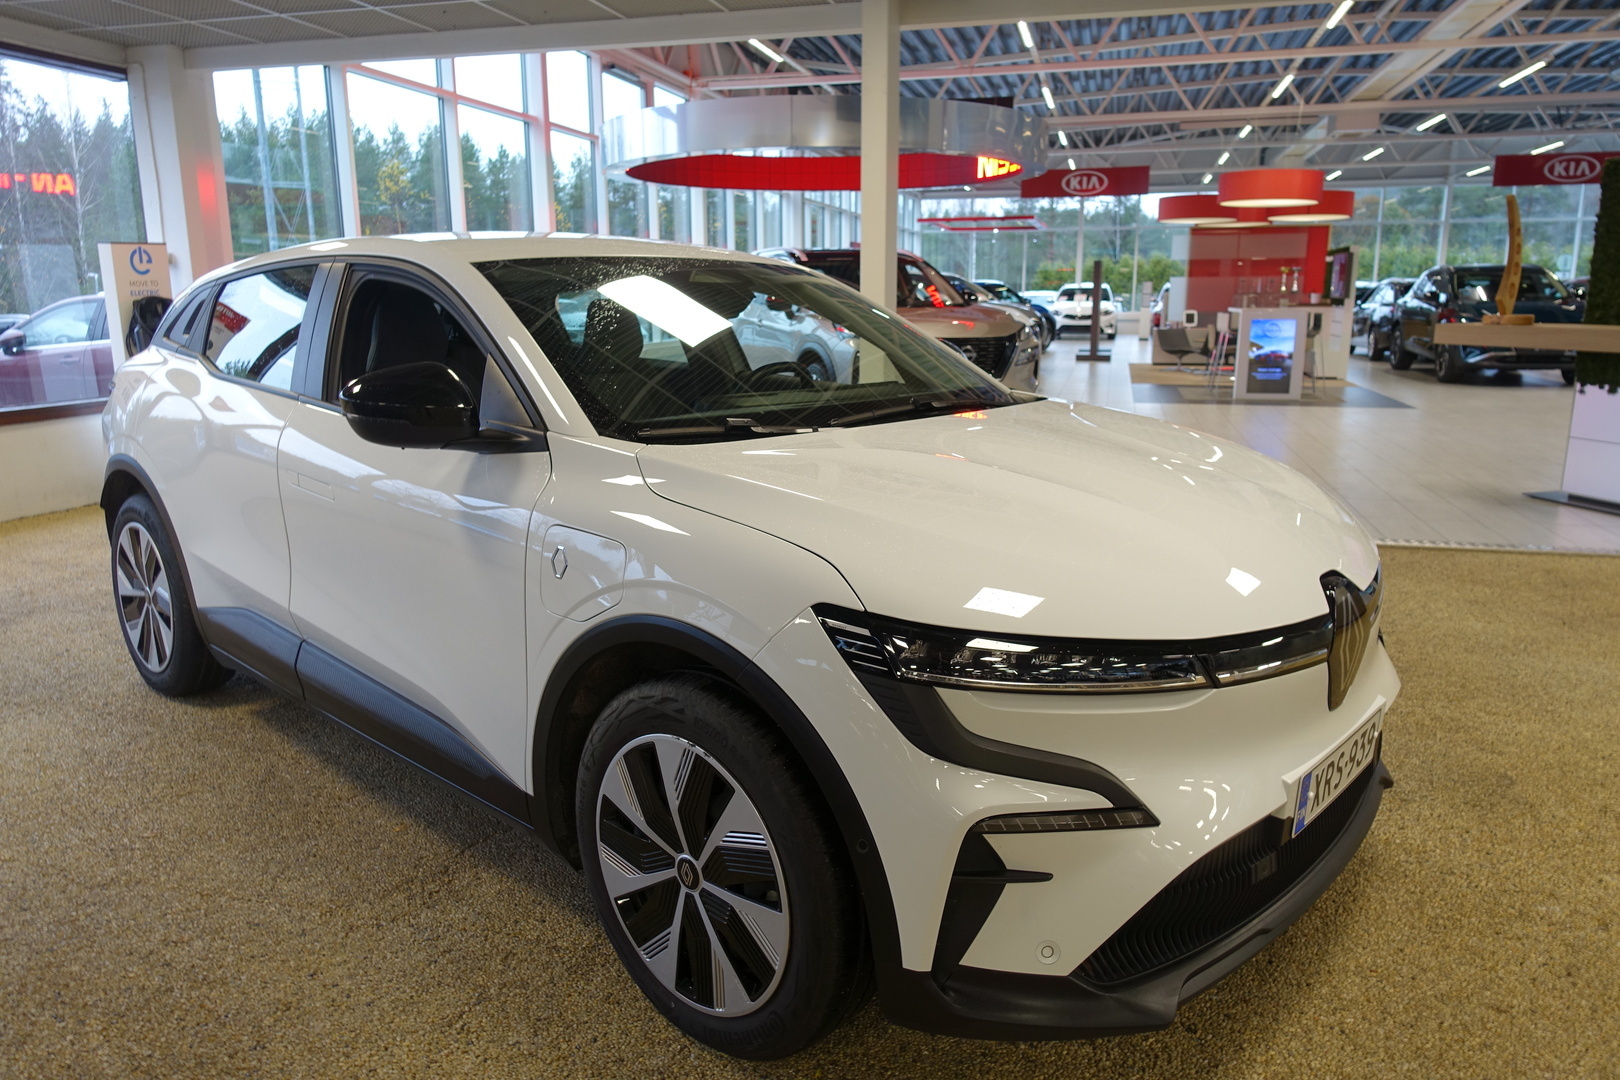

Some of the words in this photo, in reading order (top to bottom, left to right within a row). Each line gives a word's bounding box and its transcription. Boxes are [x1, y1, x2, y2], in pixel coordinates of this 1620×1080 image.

[1553, 161, 1591, 177] KIA
[1069, 176, 1101, 191] KIA
[694, 716, 729, 749] 195/60
[1310, 721, 1376, 813] XRS-939
